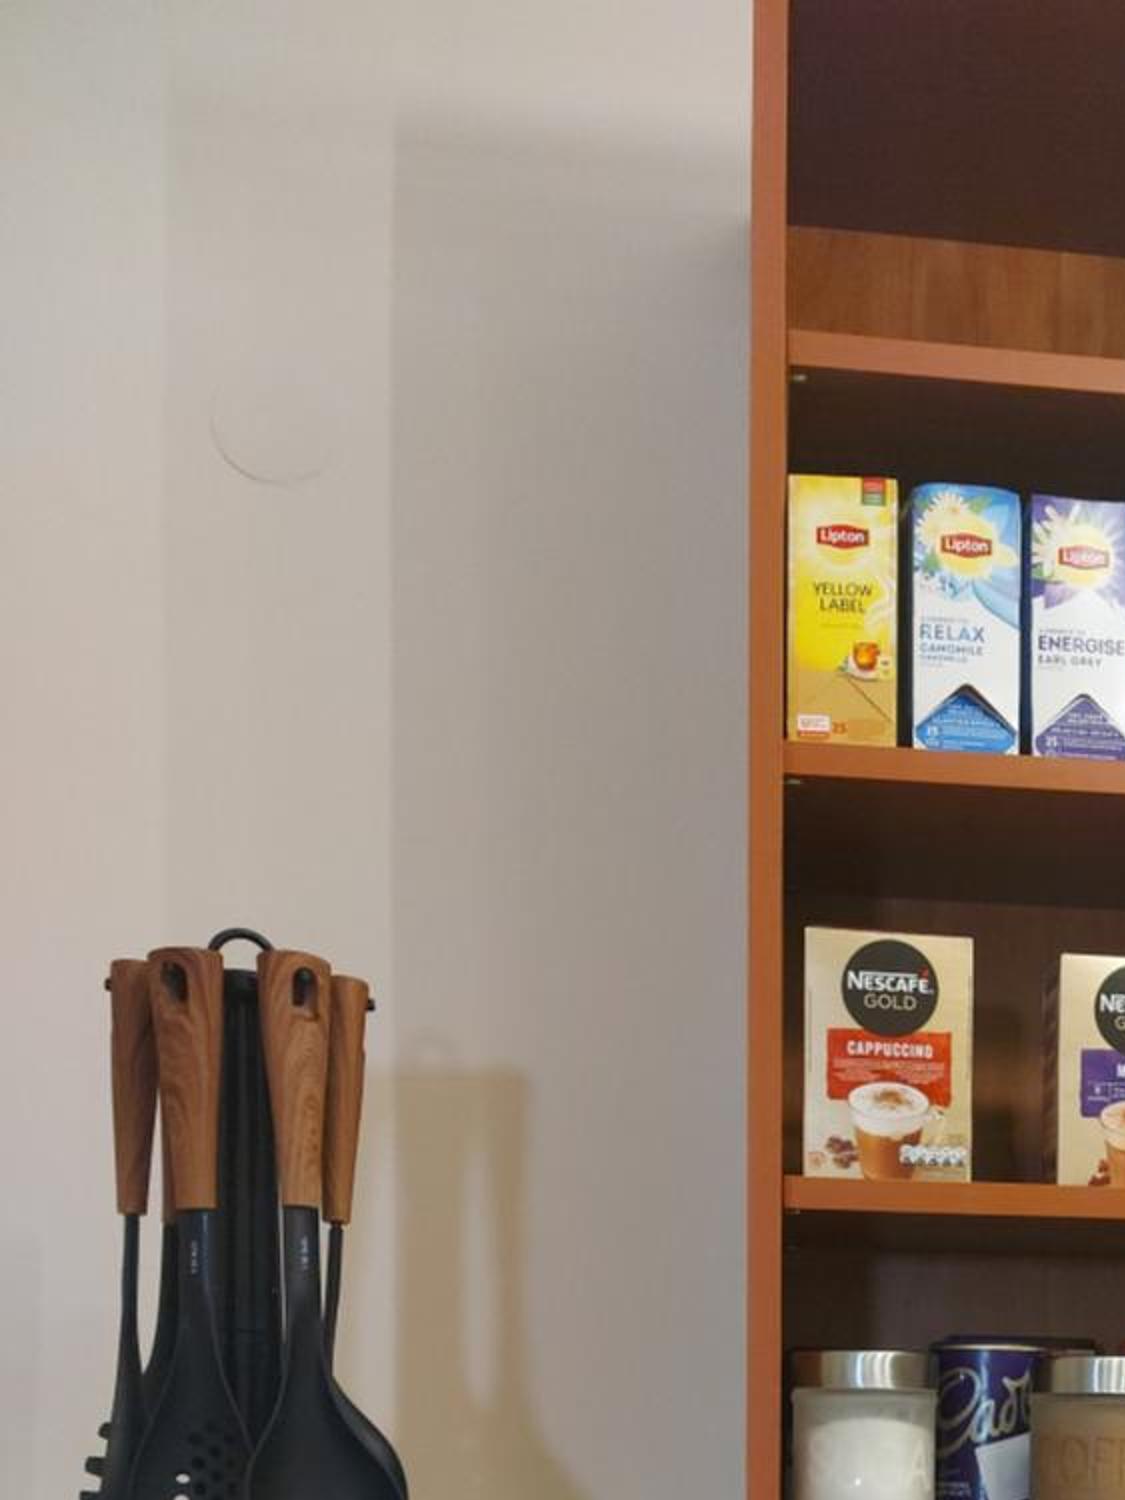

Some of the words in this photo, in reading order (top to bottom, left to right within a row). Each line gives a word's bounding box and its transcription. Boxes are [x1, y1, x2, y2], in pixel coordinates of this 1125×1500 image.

[820, 528, 865, 544] Lipton
[945, 537, 989, 554] Lipton
[1062, 549, 1106, 566] Lipton
[813, 581, 872, 597] YELLOW
[819, 598, 865, 614] LABEL
[919, 623, 985, 643] RELAX
[1038, 635, 1125, 657] ENERGISE
[863, 994, 918, 1011] GOLD
[847, 1040, 934, 1060] CAPPUCCINO
[937, 1364, 1031, 1458] Cad
